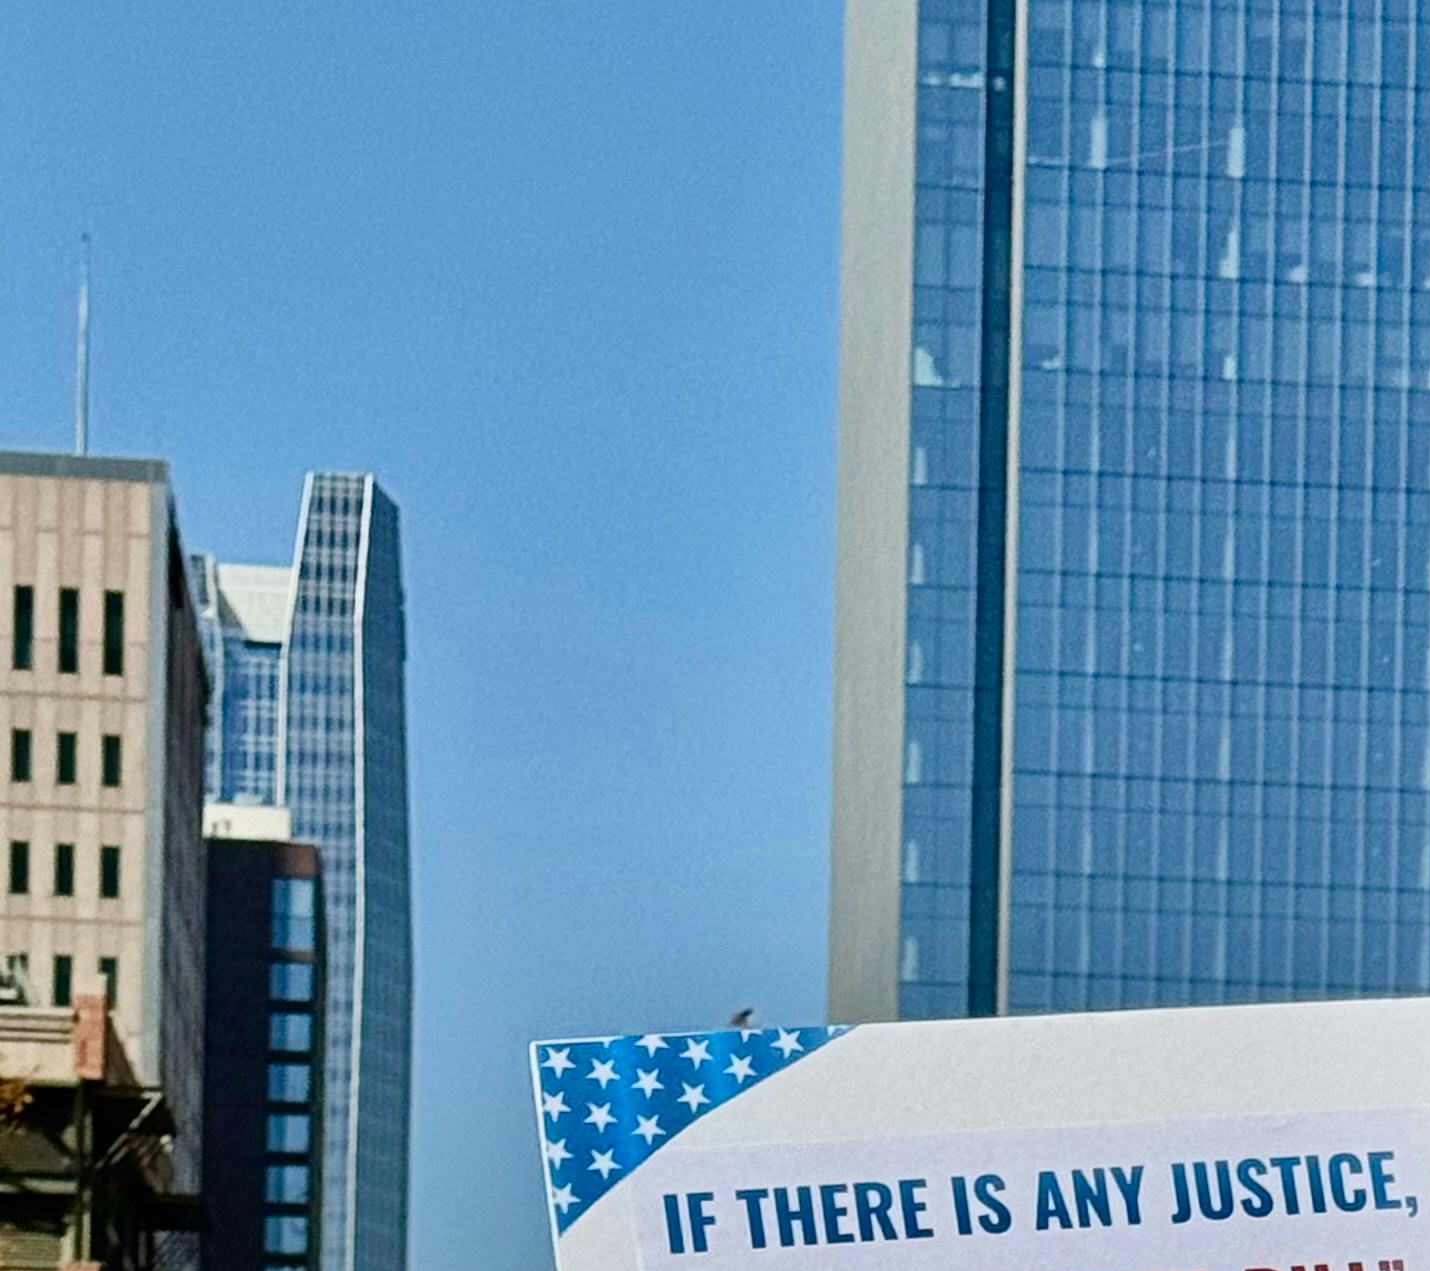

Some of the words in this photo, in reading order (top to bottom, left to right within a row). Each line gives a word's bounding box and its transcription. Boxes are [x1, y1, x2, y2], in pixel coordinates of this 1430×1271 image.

[663, 1191, 716, 1255] IF
[735, 1178, 933, 1250] THERE
[952, 1173, 1013, 1236] IS
[1035, 1165, 1145, 1232] ANY
[1170, 1150, 1419, 1226] JUSTICE,
